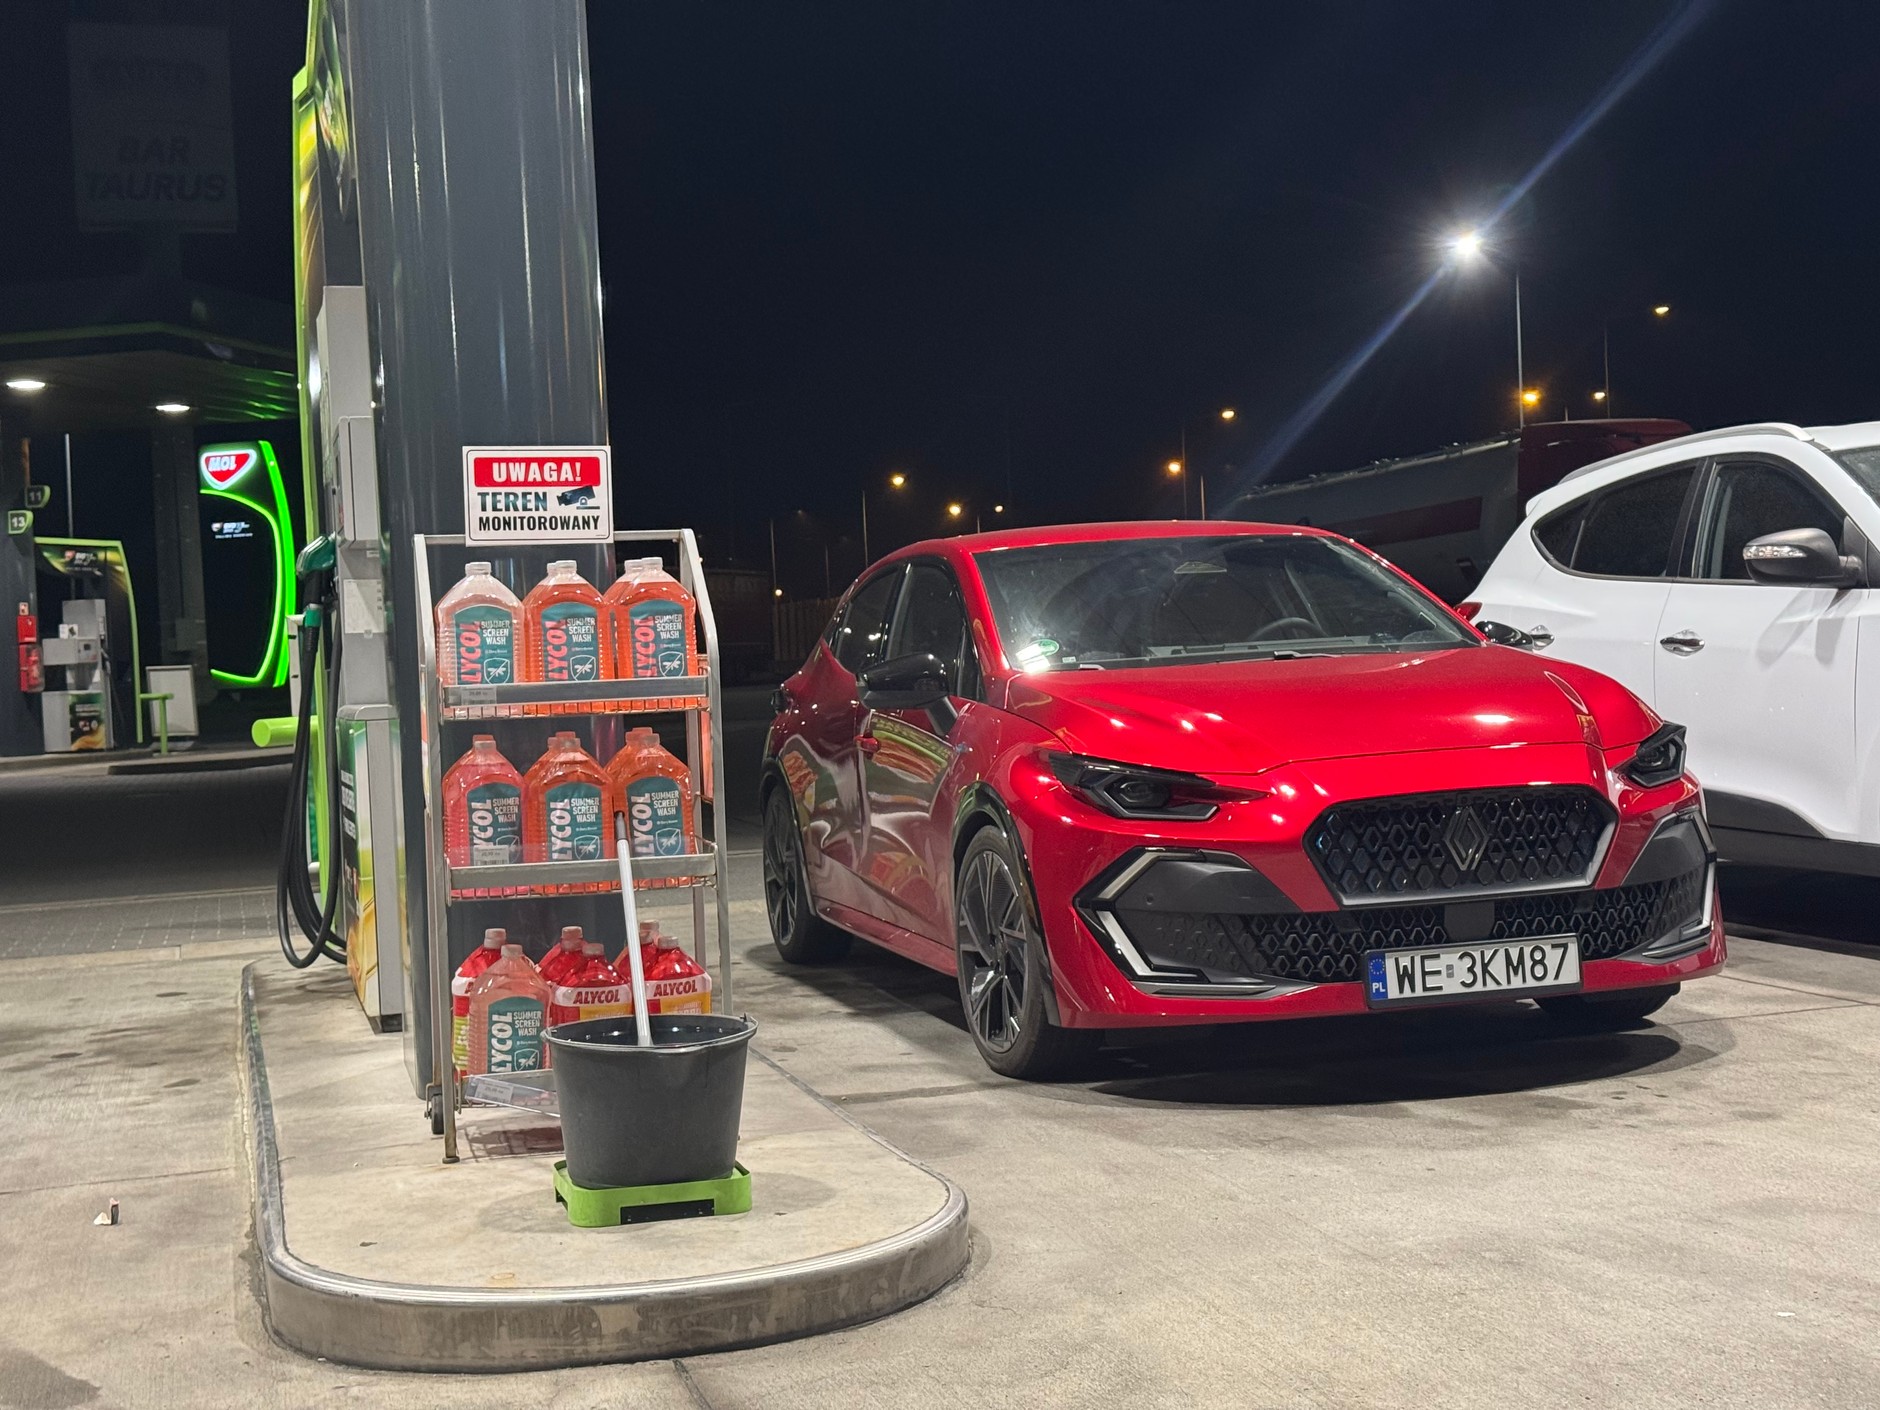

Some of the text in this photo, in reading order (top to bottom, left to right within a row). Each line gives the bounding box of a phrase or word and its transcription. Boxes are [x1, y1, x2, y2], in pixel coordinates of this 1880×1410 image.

[118, 135, 190, 164] BAR
[85, 173, 226, 202] TAURUS
[207, 455, 237, 472] MOL
[492, 462, 582, 482] UWAGA!
[30, 491, 41, 501] 11
[477, 491, 548, 512] TEREN
[12, 516, 25, 527] 13
[479, 515, 600, 531] MONITOROWANY
[567, 617, 595, 627] SUMMER
[655, 614, 682, 623] SUMMER
[569, 626, 594, 634] SCREEN
[657, 622, 681, 631] SCREEN
[482, 628, 509, 637] SCREEN
[660, 630, 679, 639] WASH
[486, 637, 506, 645] WASH
[572, 634, 592, 642] WASH
[651, 791, 679, 800] SUMMER
[493, 797, 519, 806] SUMMER
[571, 797, 599, 806] SUMMER
[654, 799, 678, 808] SCREEN
[495, 806, 518, 815] SCREEN
[573, 805, 598, 815] SCREEN
[657, 807, 676, 816] WASH
[498, 814, 516, 823] WASH
[576, 814, 595, 823] WASH
[1394, 942, 1569, 995] WE 3KM87
[654, 980, 697, 997] ALYCOL
[1371, 981, 1386, 993] PL
[573, 989, 620, 1004] ALYCOL
[514, 1011, 541, 1020] SUMMER
[515, 1019, 540, 1028] SCREEN
[518, 1027, 537, 1036] WASH
